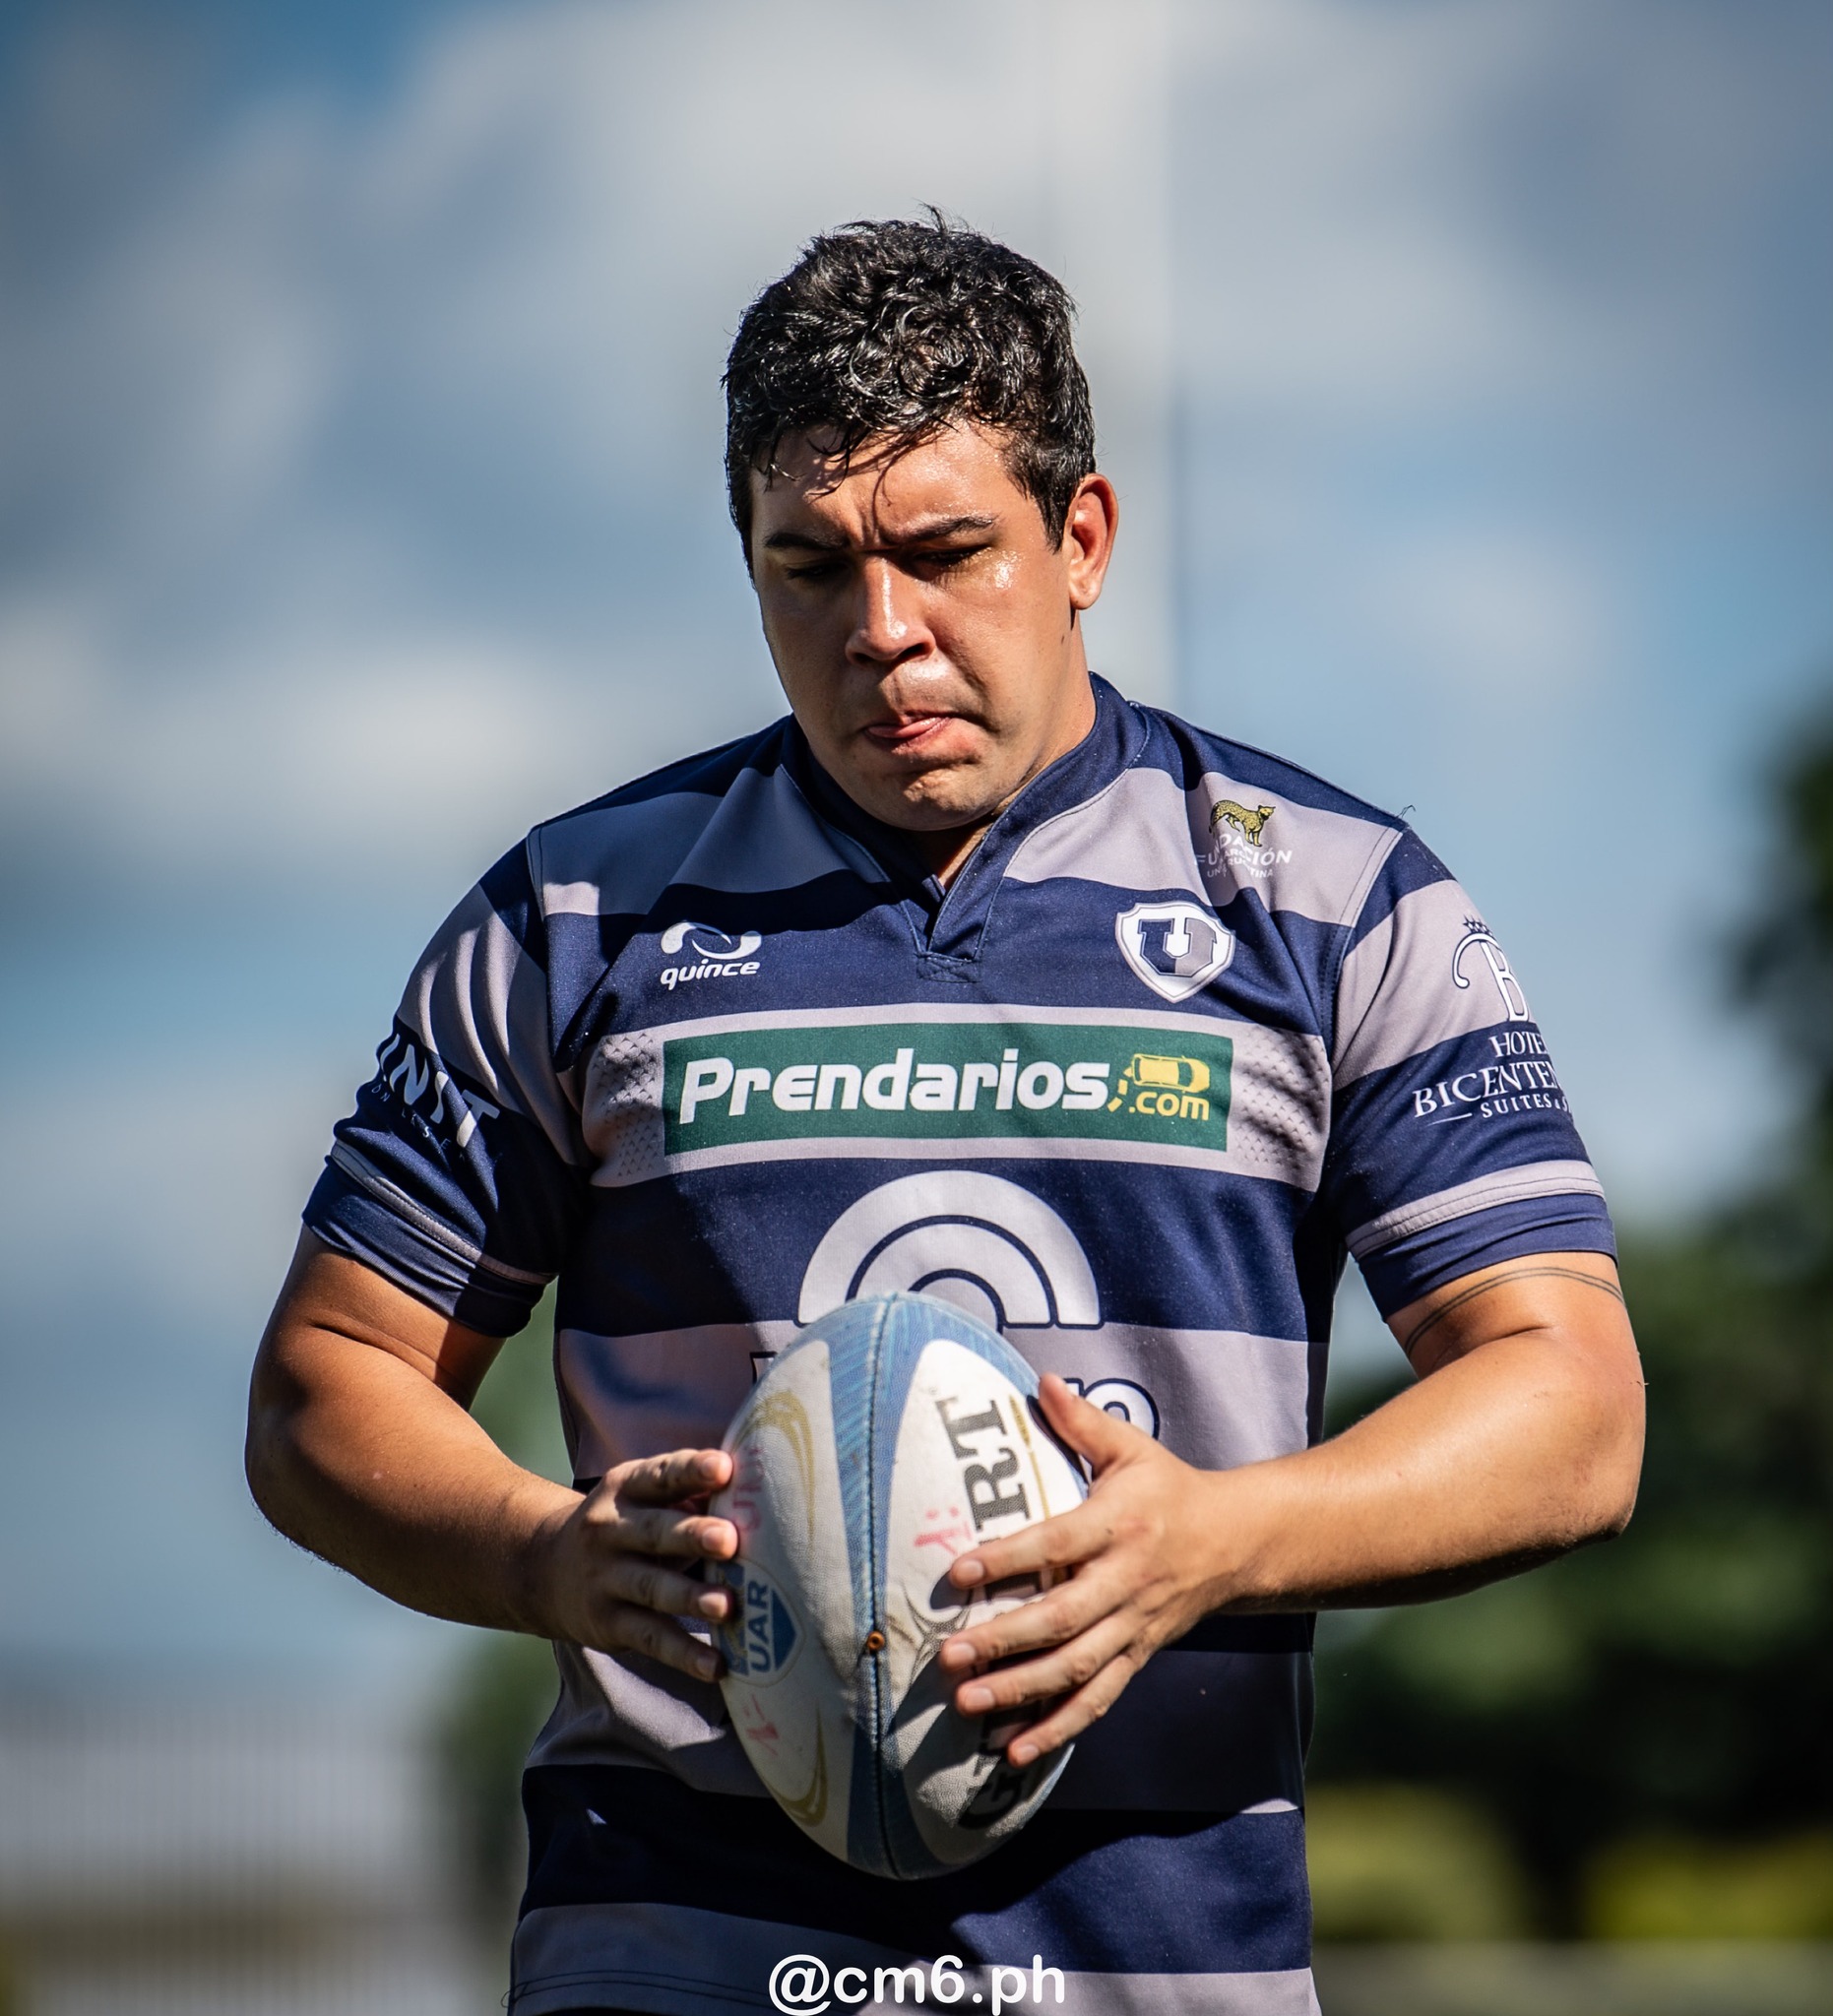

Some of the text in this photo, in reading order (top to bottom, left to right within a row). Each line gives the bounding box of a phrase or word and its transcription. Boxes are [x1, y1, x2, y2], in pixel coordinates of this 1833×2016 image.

[660, 958, 761, 991] quince
[1480, 1093, 1552, 1118] SUITES
[746, 1579, 773, 1673] UAR
